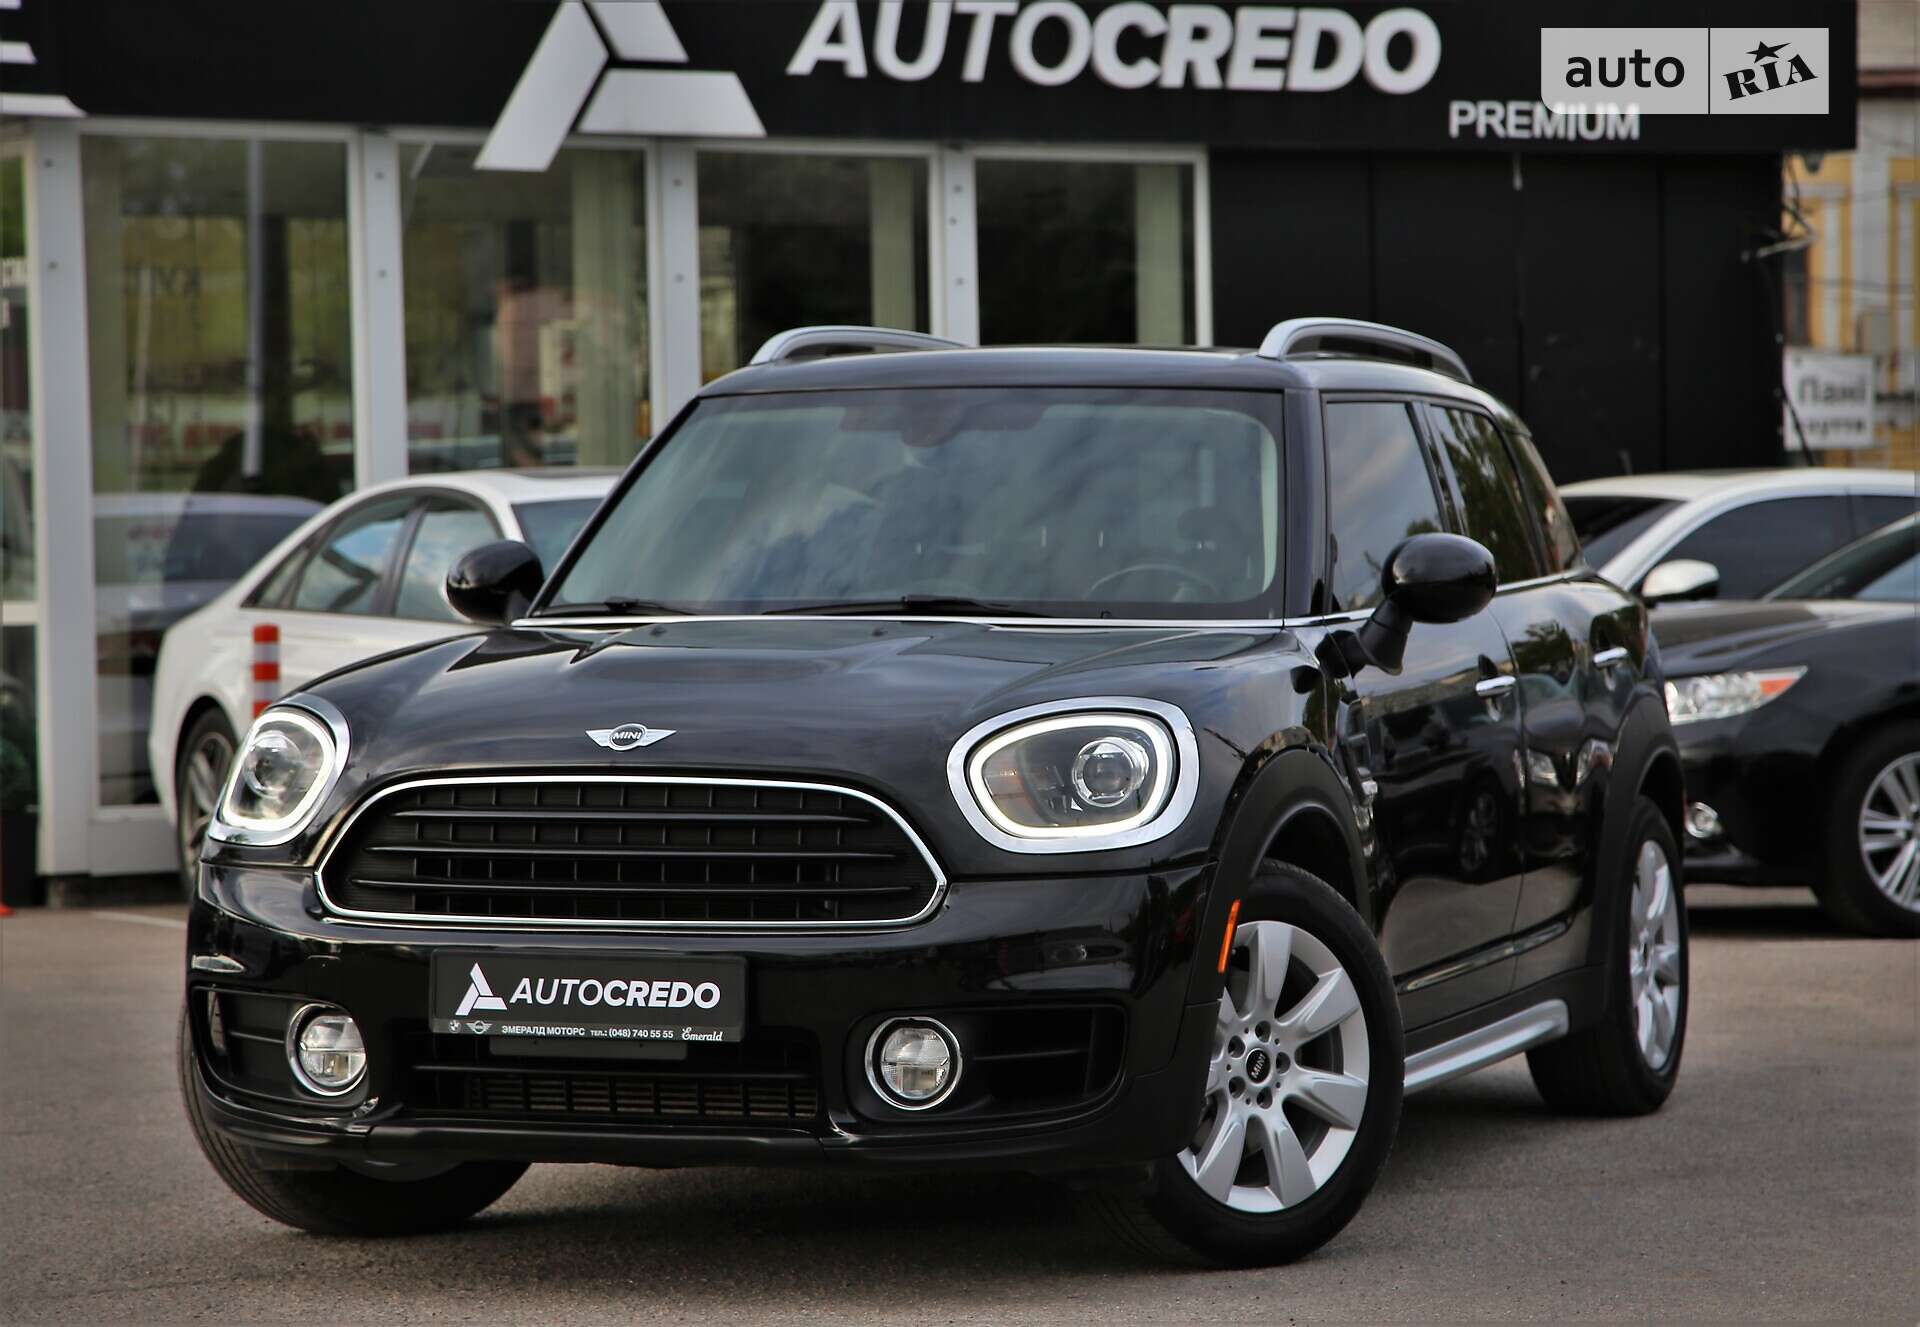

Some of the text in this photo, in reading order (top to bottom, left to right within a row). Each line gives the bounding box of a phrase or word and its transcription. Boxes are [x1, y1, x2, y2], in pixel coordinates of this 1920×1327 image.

[786, 0, 1441, 95] AUTOCREDO
[1448, 100, 1641, 141] PREMIUM
[612, 731, 642, 740] MINI
[510, 977, 721, 1010] AUTOCREDO
[501, 1025, 546, 1036] ЭМЕРАЛД
[546, 1027, 585, 1036] МОТОРС
[608, 1028, 631, 1039] (048)
[632, 1029, 649, 1038] 740
[650, 1030, 661, 1038] 55
[662, 1030, 674, 1038] 55
[681, 1026, 723, 1042] Emerald
[1251, 1053, 1266, 1079] MINI
